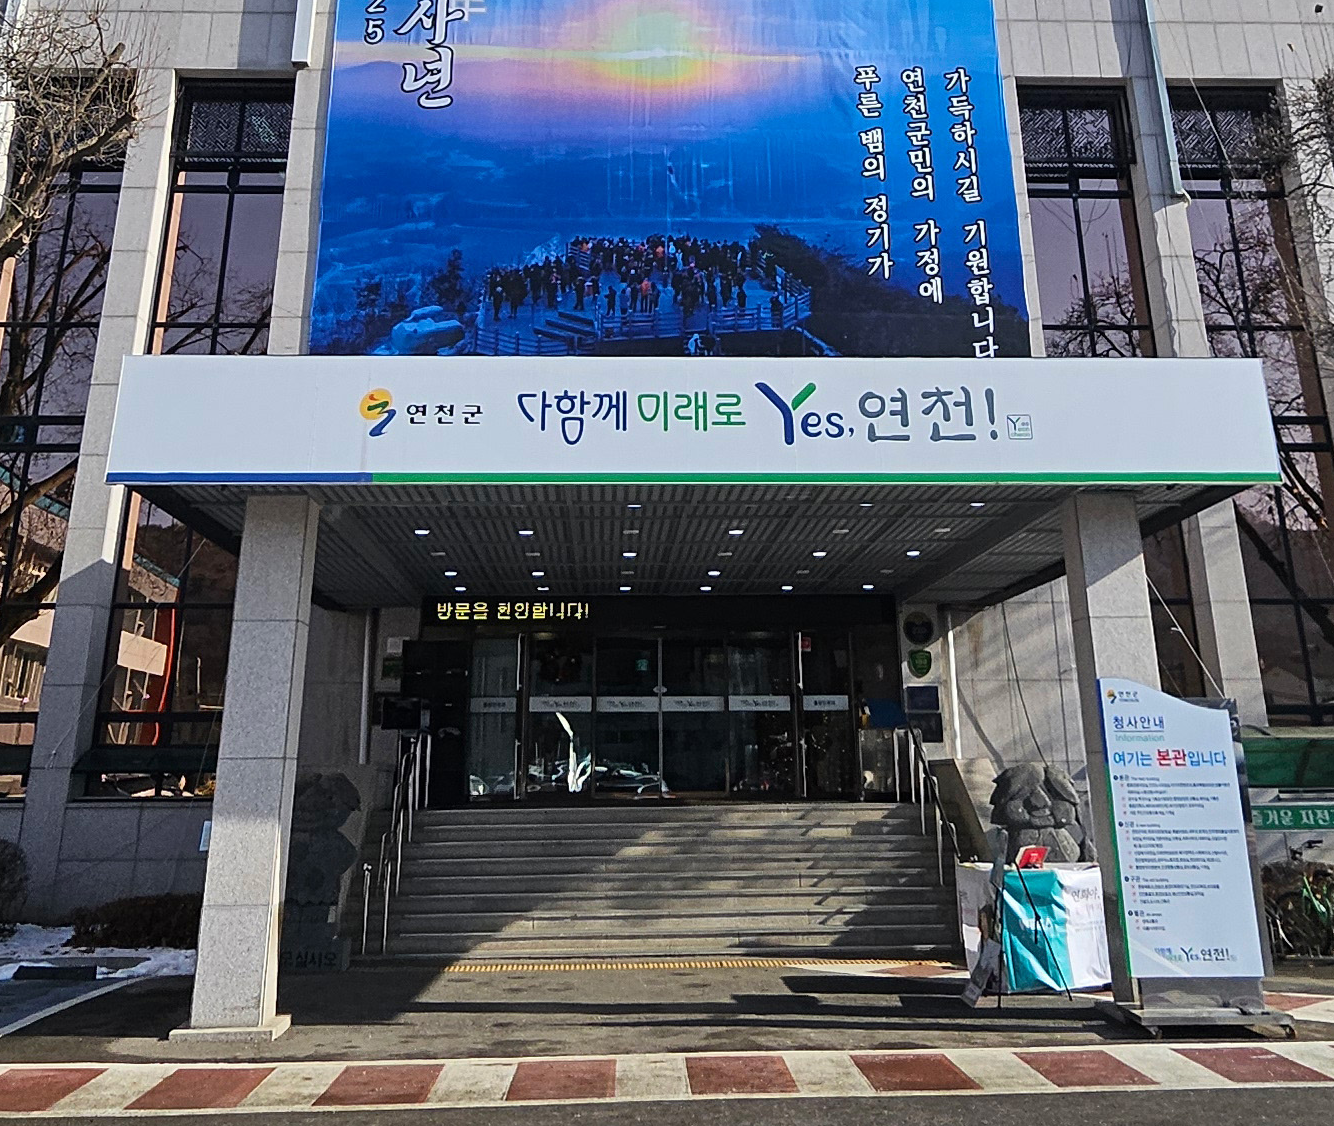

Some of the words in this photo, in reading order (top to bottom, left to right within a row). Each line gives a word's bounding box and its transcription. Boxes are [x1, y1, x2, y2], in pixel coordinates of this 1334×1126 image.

[854, 64, 884, 118] 푸른
[859, 127, 886, 181] 뱀의
[901, 67, 936, 201] 연천군민의
[864, 194, 895, 279] 정기가
[944, 68, 983, 202] 가득하시길
[964, 219, 1000, 358] 기원합니다
[913, 219, 944, 304] 가정에
[406, 404, 483, 424] 연천군
[517, 389, 627, 446] 다함께
[637, 391, 747, 432] 미래로
[858, 386, 998, 442] 연천!
[437, 602, 489, 620] 방문을
[1113, 716, 1164, 729] 청사안내
[1113, 751, 1152, 766] 여기는
